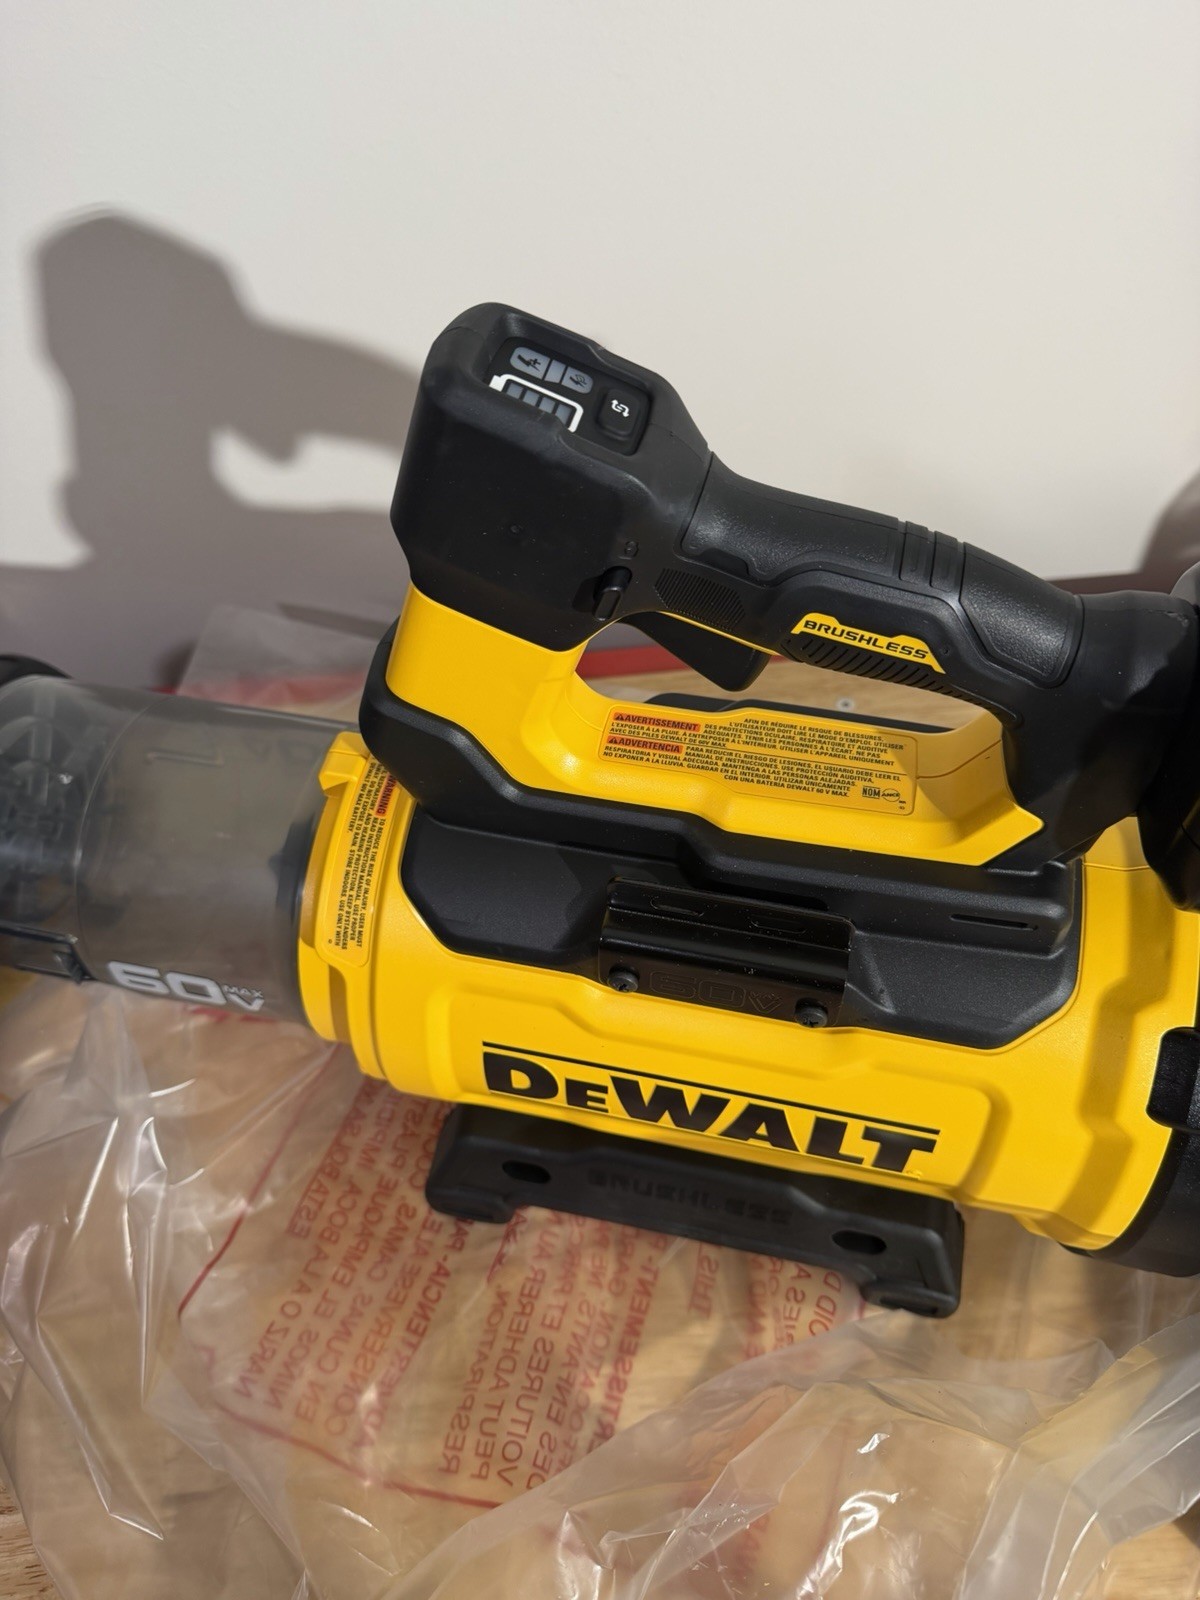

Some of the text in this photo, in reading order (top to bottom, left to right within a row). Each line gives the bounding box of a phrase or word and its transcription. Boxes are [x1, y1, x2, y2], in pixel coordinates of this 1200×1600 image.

[803, 619, 929, 659] BRUSHLESS
[624, 714, 698, 731] AVERTISSEMENT
[618, 737, 680, 752] ADVERTENCIA
[861, 786, 880, 797] NOM
[358, 800, 369, 821] EXPOSE
[357, 825, 369, 852] HEARING
[346, 848, 355, 868] STORE
[361, 833, 374, 871] INSTRUCTION
[346, 894, 354, 909] KEEP
[350, 916, 358, 940] PROPER
